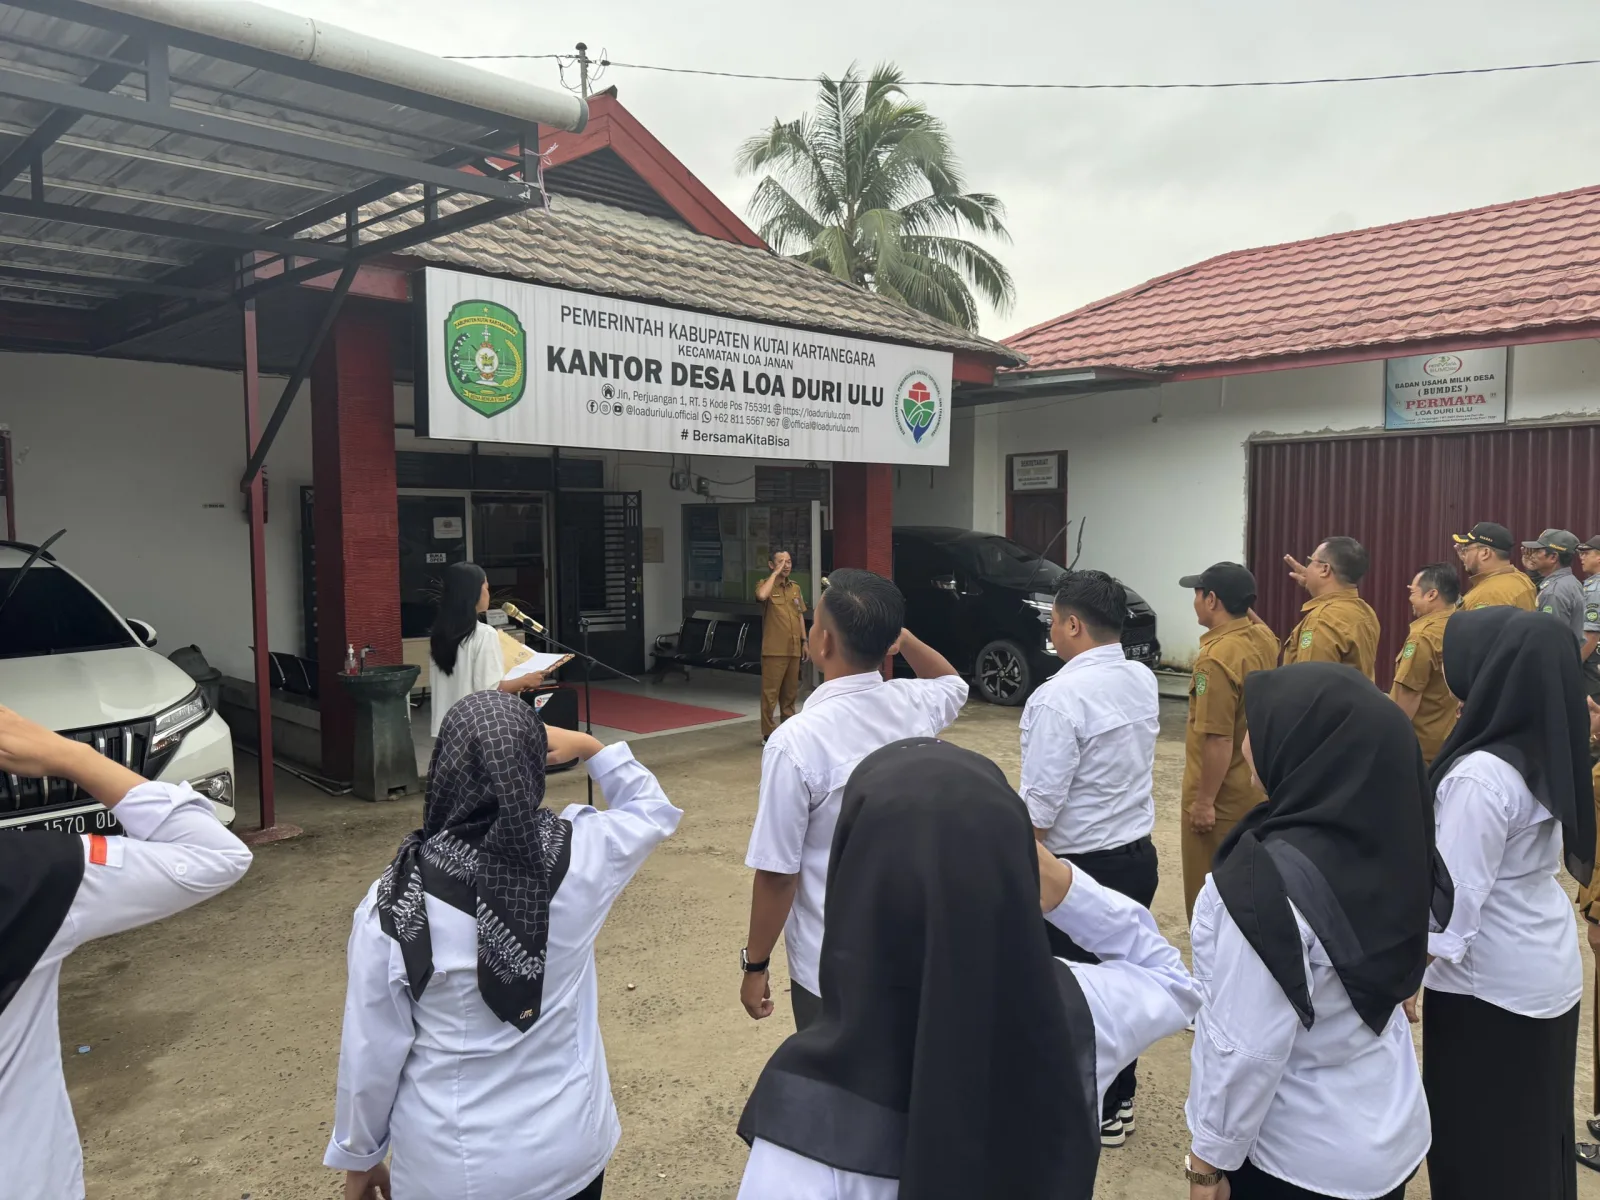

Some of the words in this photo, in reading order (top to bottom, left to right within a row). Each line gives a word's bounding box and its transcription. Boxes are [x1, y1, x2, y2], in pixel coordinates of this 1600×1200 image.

[561, 305, 664, 338] PEMERINTAH
[669, 322, 750, 350] KABUPATEN
[753, 337, 789, 355] KUTAI
[792, 341, 876, 367] KARTANEGARA
[678, 345, 740, 363] KECAMATAN
[743, 354, 762, 366] LOA
[763, 357, 794, 370] JANAN
[547, 345, 662, 384] KANTOR
[671, 362, 735, 392] DESA
[742, 372, 785, 398] LOA
[792, 376, 841, 403] DURI
[848, 384, 884, 407] ULU
[1395, 381, 1420, 389] BADAN
[1422, 378, 1448, 387] USAHA
[633, 390, 678, 406] Perjuangan
[689, 396, 700, 407] RT.
[702, 397, 708, 408] 5
[709, 398, 728, 409] Kode
[730, 400, 743, 411] Pos
[744, 401, 772, 413] 755391
[783, 405, 851, 420] https://loaduriulu.com
[1405, 394, 1487, 410] PERMATA
[626, 404, 699, 421] @loaduriulu.official
[714, 413, 729, 423] +62
[730, 414, 745, 425] 811
[746, 415, 764, 426] 5567
[766, 417, 780, 427] 967
[681, 429, 689, 441] #
[693, 429, 790, 447] BersamaKitaBisa
